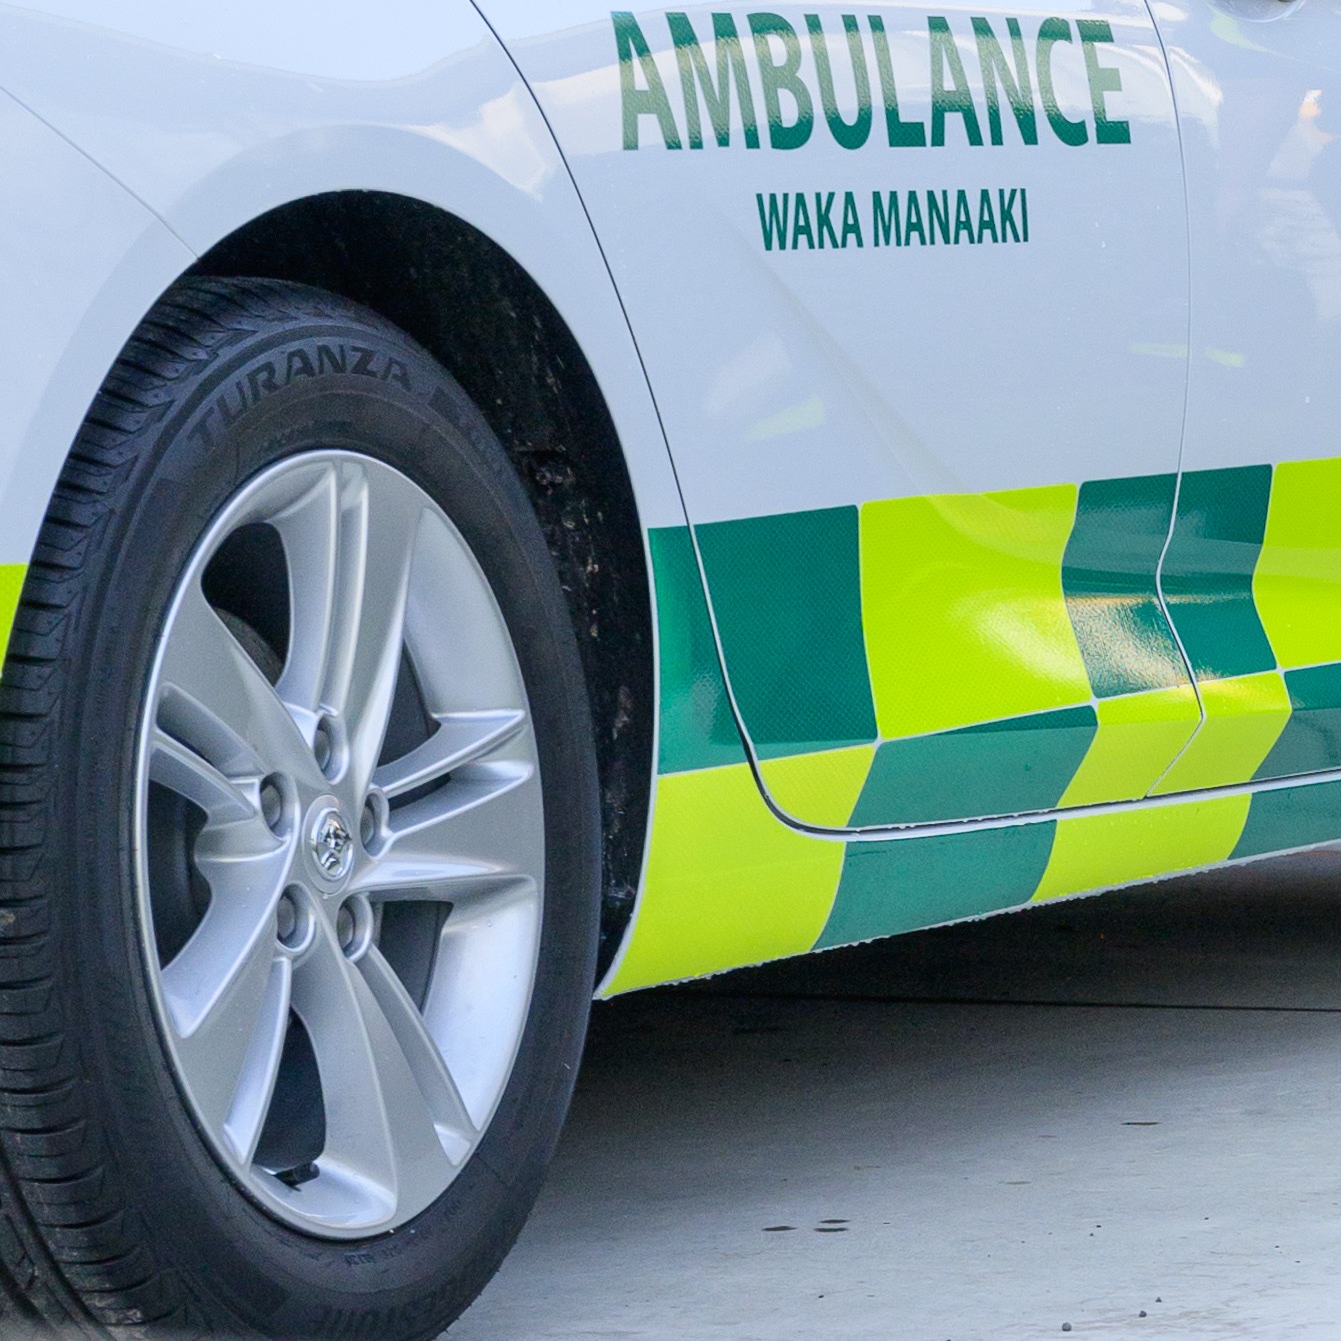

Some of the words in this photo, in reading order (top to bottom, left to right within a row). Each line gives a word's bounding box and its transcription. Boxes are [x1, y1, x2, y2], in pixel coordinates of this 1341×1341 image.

[609, 10, 1132, 151] AMBULANCE
[755, 190, 864, 251] WAKA
[871, 187, 1030, 249] MANAAKI
[186, 343, 413, 449] TURANZA
